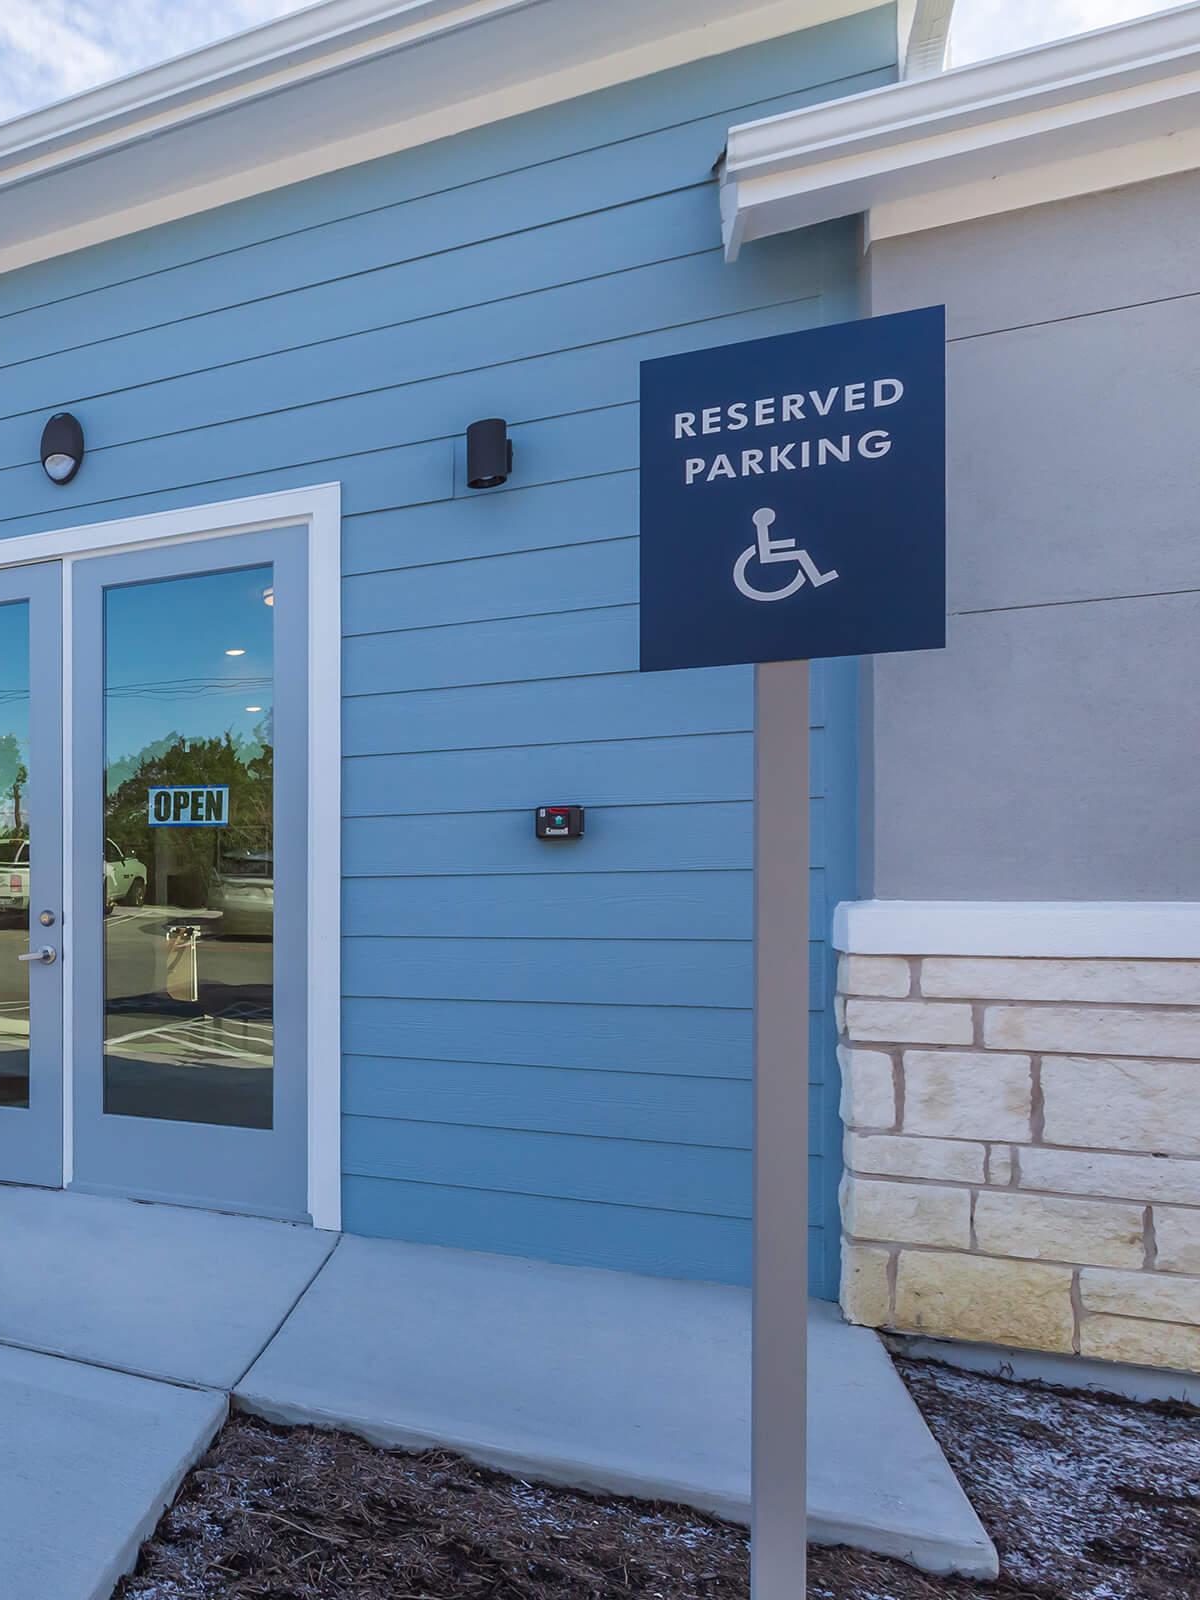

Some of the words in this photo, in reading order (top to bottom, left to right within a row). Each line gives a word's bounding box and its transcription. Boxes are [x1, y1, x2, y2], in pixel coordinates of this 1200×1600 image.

[674, 378, 904, 439] RESERVED
[685, 430, 892, 485] PARKING
[154, 790, 223, 822] OPEN
